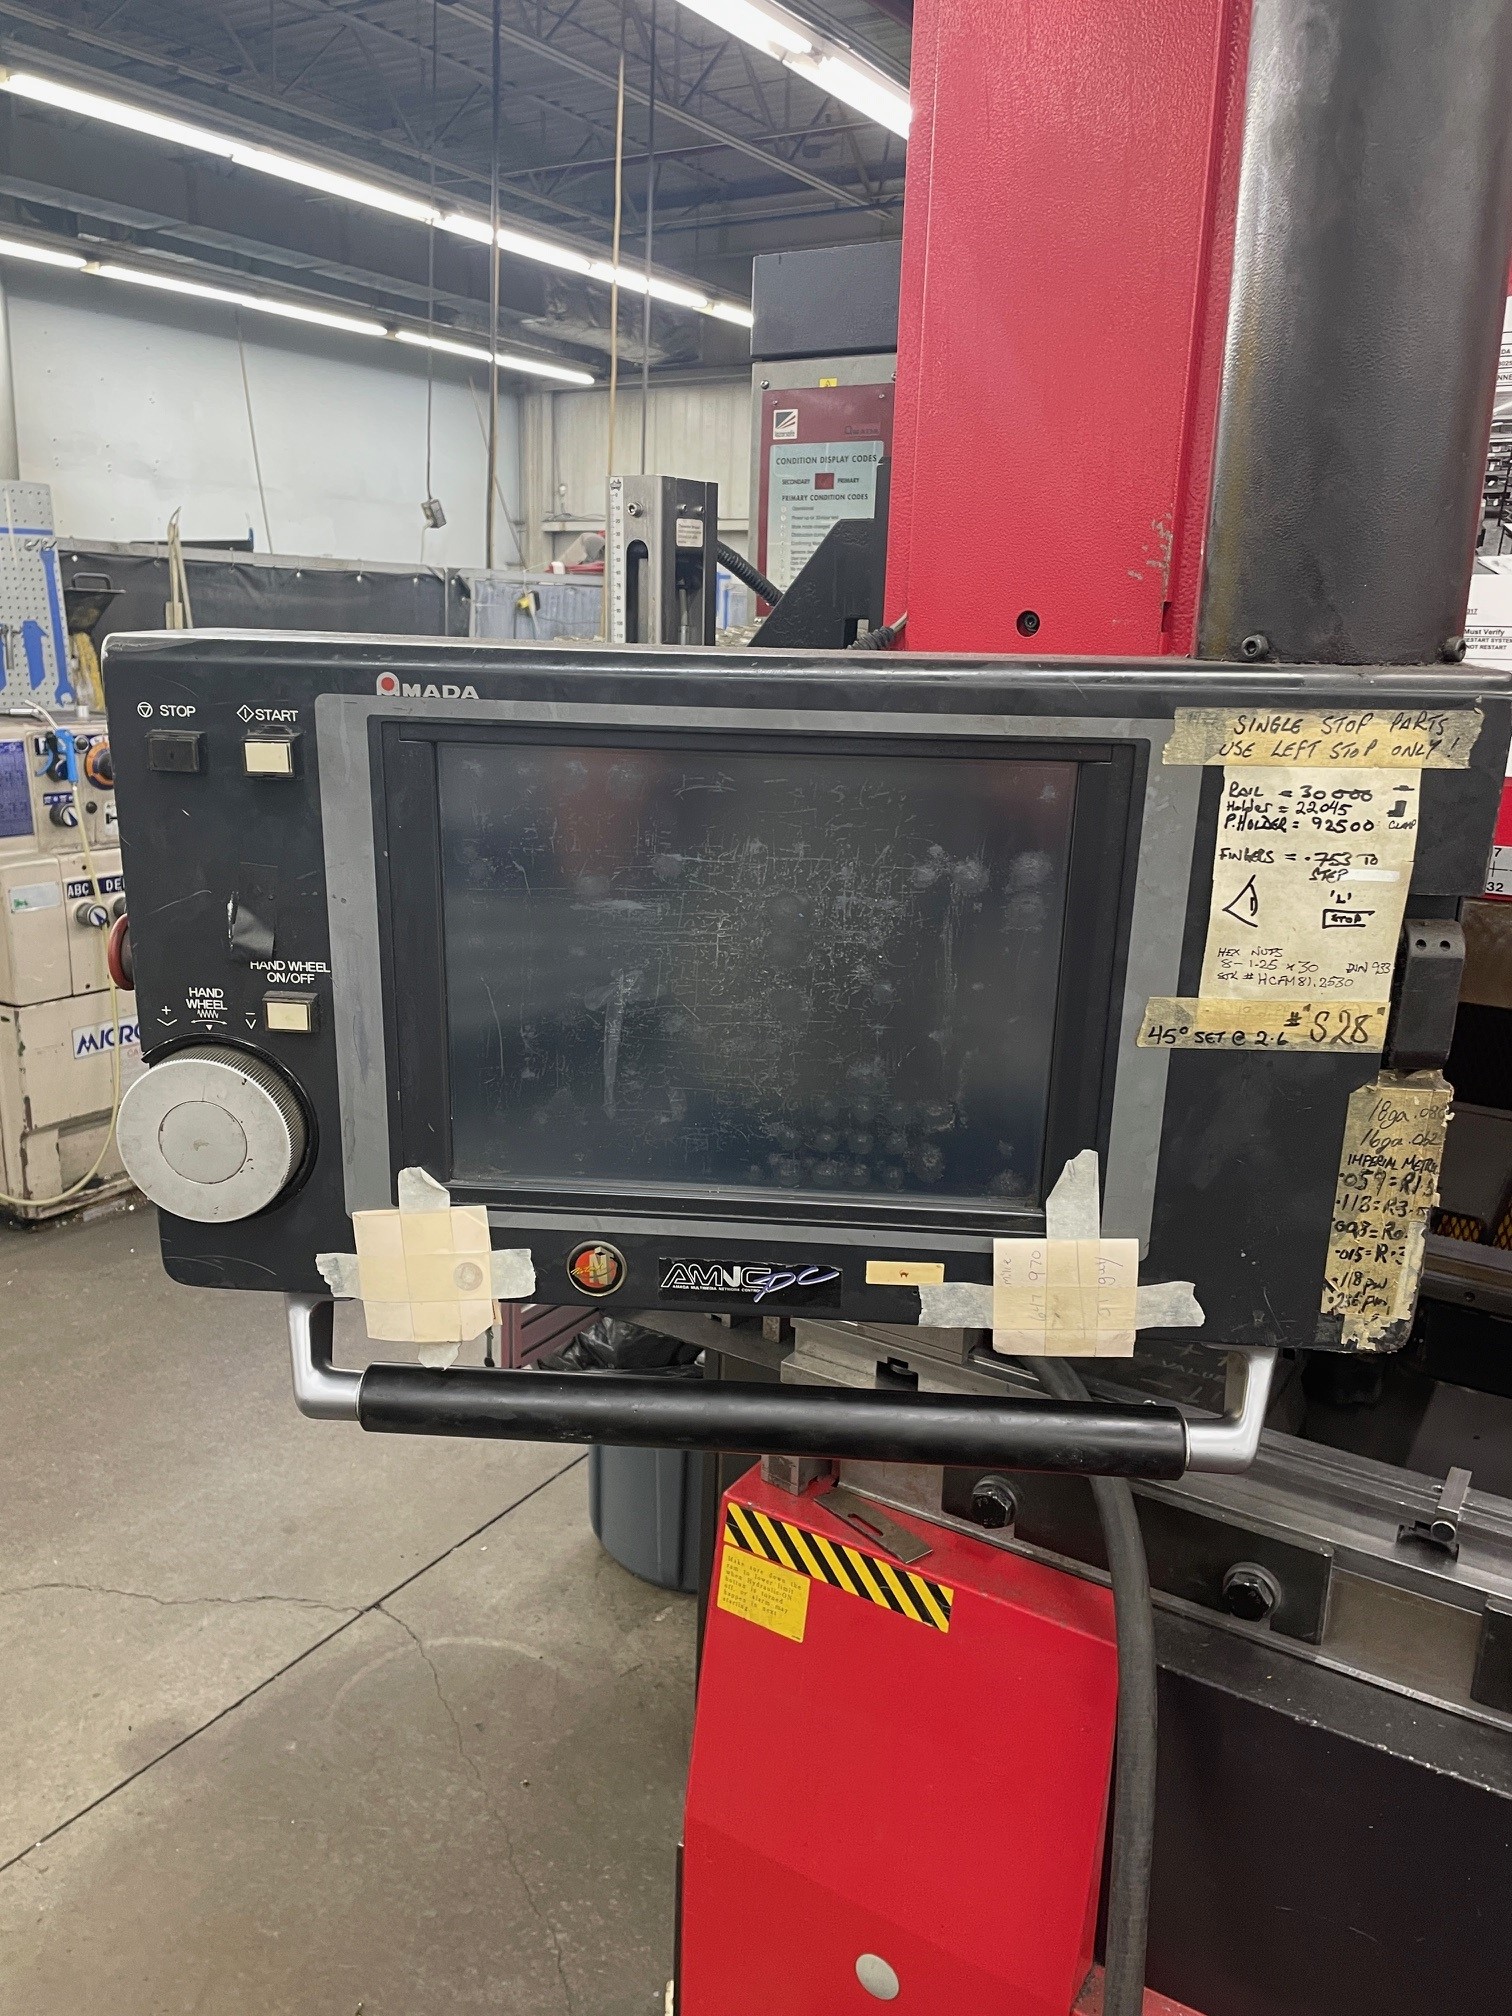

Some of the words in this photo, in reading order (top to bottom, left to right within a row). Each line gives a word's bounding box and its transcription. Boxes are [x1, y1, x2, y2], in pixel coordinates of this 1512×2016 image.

[776, 457, 817, 465] CONDITION
[820, 455, 849, 463] DISPLAY
[852, 455, 877, 463] CODES
[1483, 629, 1505, 637] Verify
[376, 671, 480, 700] AMADA
[159, 705, 196, 718] STOP
[255, 709, 299, 722] START
[1233, 714, 1303, 735] SINGLE
[1320, 712, 1374, 735] STOP
[1389, 712, 1449, 735] PARTS
[1218, 742, 1253, 758] USE
[1270, 740, 1322, 758] LEFT
[1329, 740, 1379, 758] STOP
[1295, 801, 1353, 816] 22045
[1311, 817, 1375, 833] 92500
[1494, 847, 1503, 858] 7
[67, 882, 89, 898] ABC
[1486, 881, 1504, 893] 32
[1217, 947, 1241, 958] HEX
[1251, 946, 1284, 958] NUTS
[250, 960, 286, 971] HAND
[287, 961, 331, 973] WHEEL
[1371, 961, 1392, 976] 933
[266, 972, 315, 984] ON/OFF
[188, 987, 224, 999] HAND
[185, 998, 228, 1011] WHEEL
[1194, 1031, 1226, 1044] SET
[1232, 1030, 1247, 1046] @
[1347, 1153, 1399, 1171] IMPERIAL
[1028, 1249, 1046, 1282] 970
[661, 1263, 772, 1289] AMNC
[1029, 1294, 1047, 1322] 647
[726, 1571, 742, 1580] when
[769, 1573, 786, 1583] down
[791, 1582, 802, 1590] the
[754, 1574, 773, 1585] lower
[778, 1583, 794, 1594] limit
[724, 1589, 746, 1602] happen
[762, 1607, 777, 1616] next
[752, 1595, 770, 1605] alarm
[761, 1592, 784, 1604] turned
